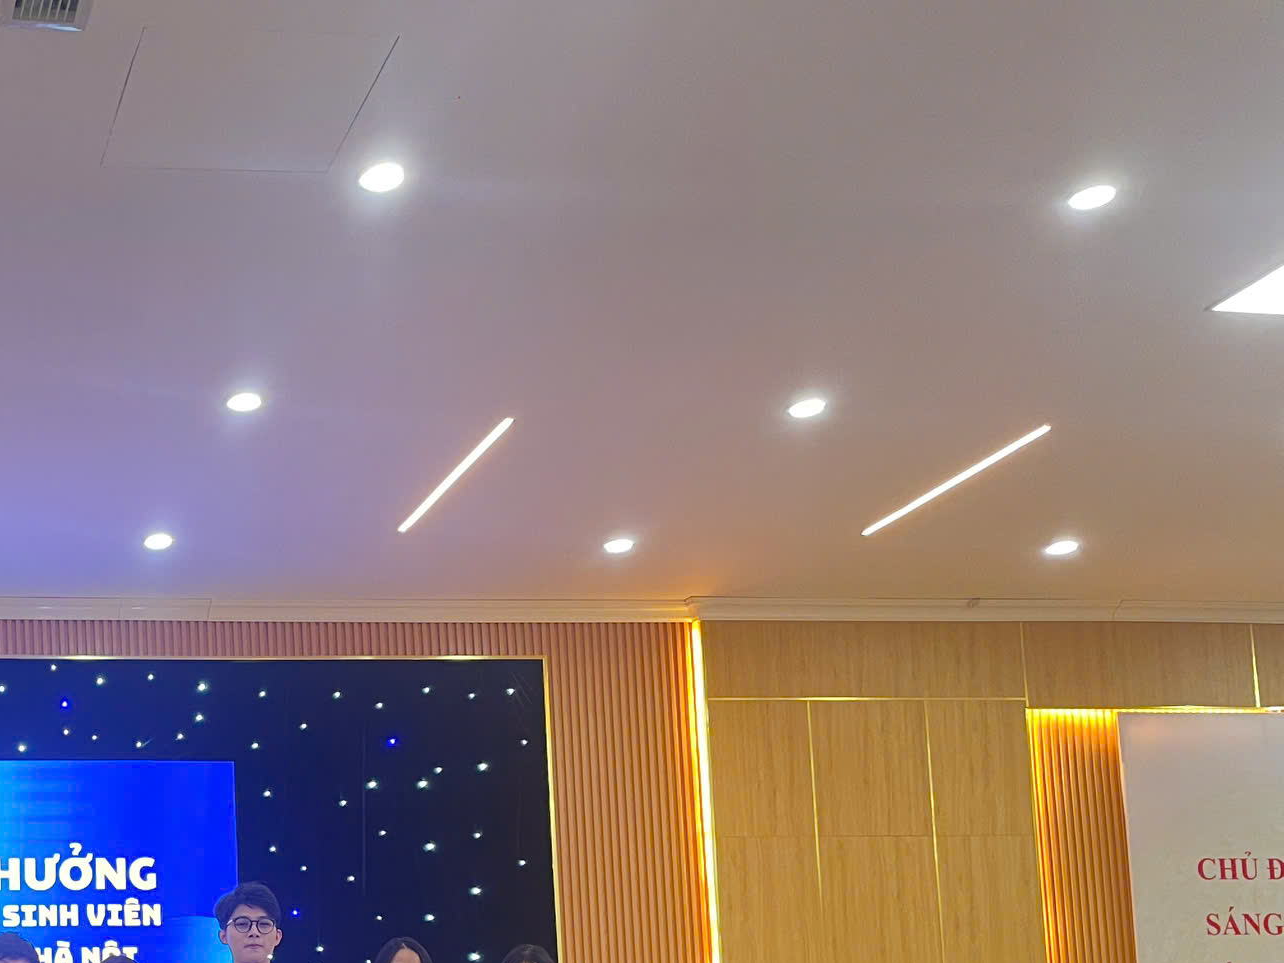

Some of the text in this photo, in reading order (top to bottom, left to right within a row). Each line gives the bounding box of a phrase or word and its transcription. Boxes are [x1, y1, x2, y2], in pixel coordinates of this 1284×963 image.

[1198, 851, 1258, 880] CHỦ
[2, 904, 80, 927] SINH
[86, 898, 162, 927] VIÊN
[1206, 906, 1284, 936] SÁNG
